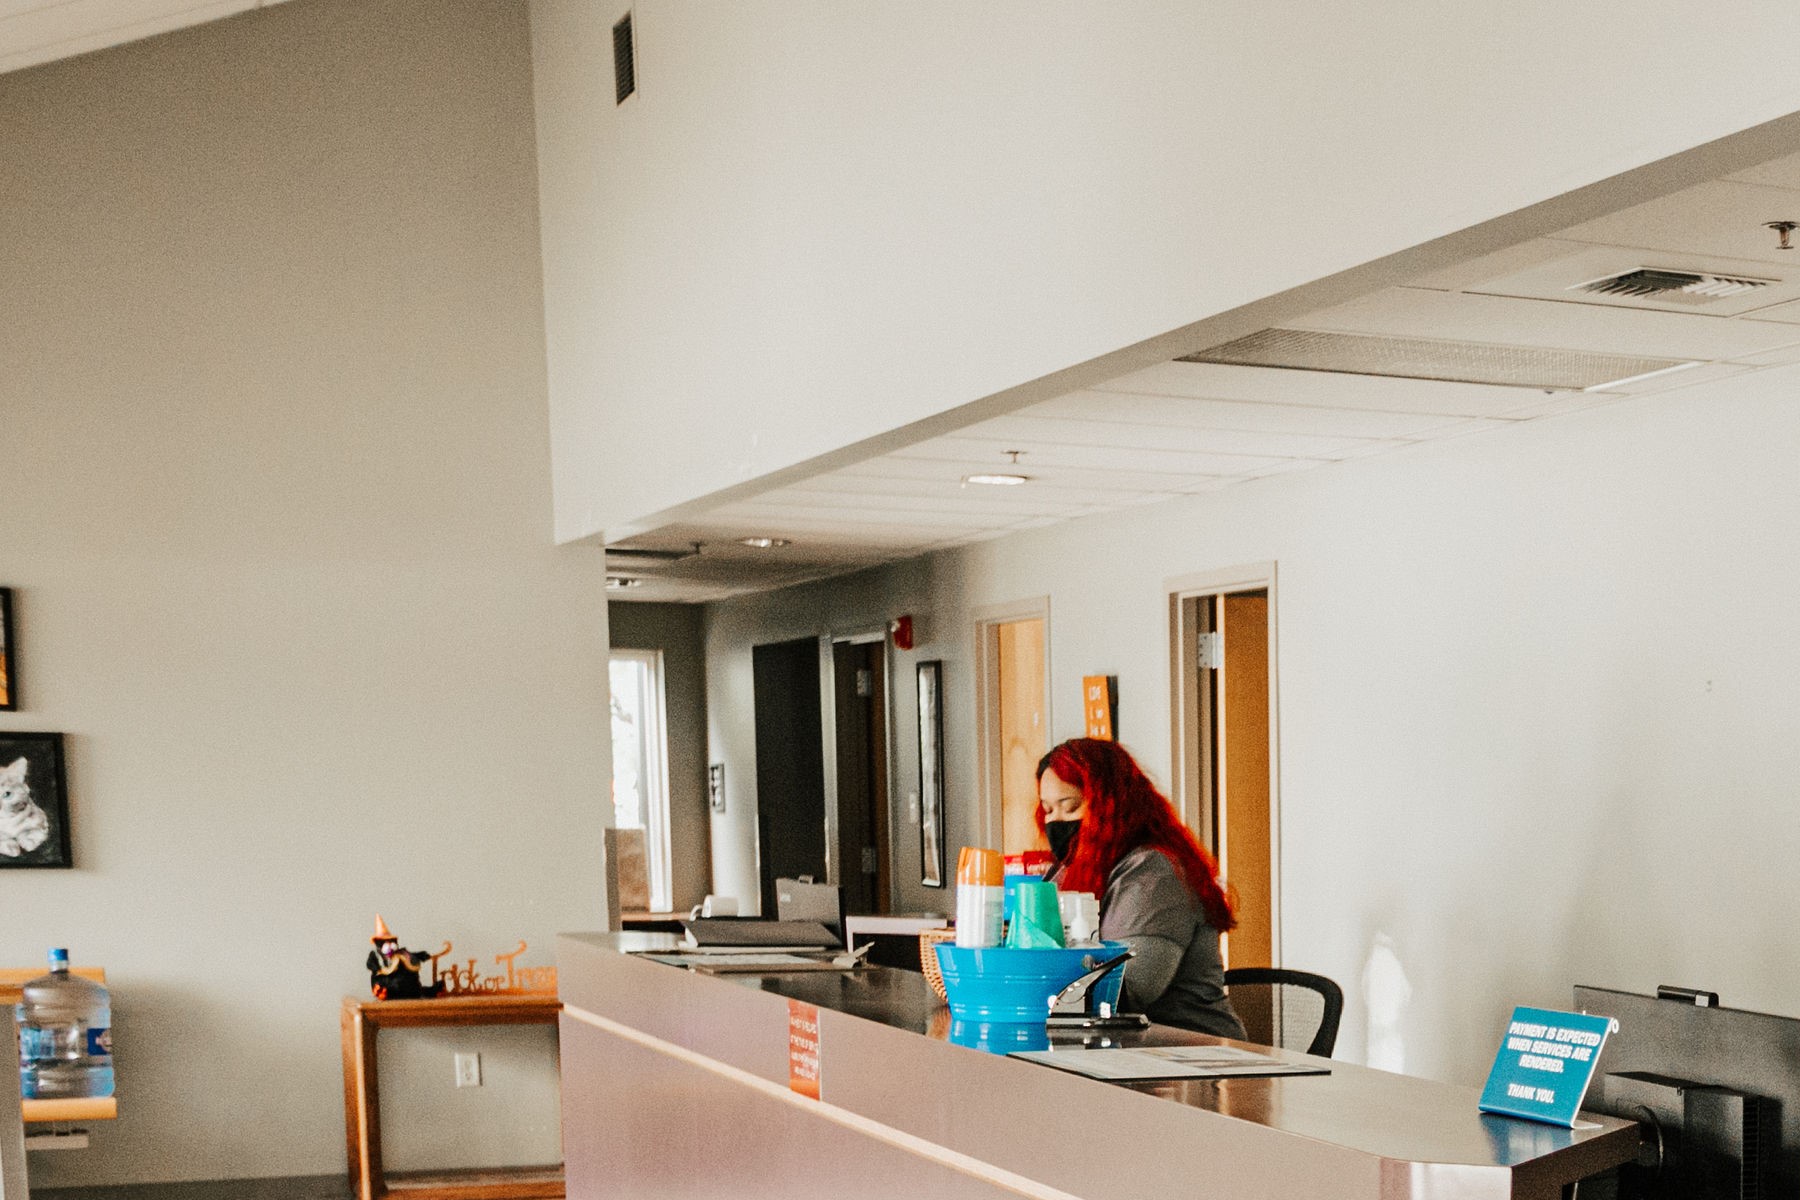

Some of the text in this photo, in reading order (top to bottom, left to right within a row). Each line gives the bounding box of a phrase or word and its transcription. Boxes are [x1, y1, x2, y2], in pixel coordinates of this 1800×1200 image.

[1509, 1022, 1601, 1047] PAYMENT IS EXPECTED
[1508, 1037, 1592, 1061] WHEN SERVICES ARE
[1519, 1054, 1564, 1073] RENDERED.
[1508, 1083, 1555, 1104] THANK YOU.
